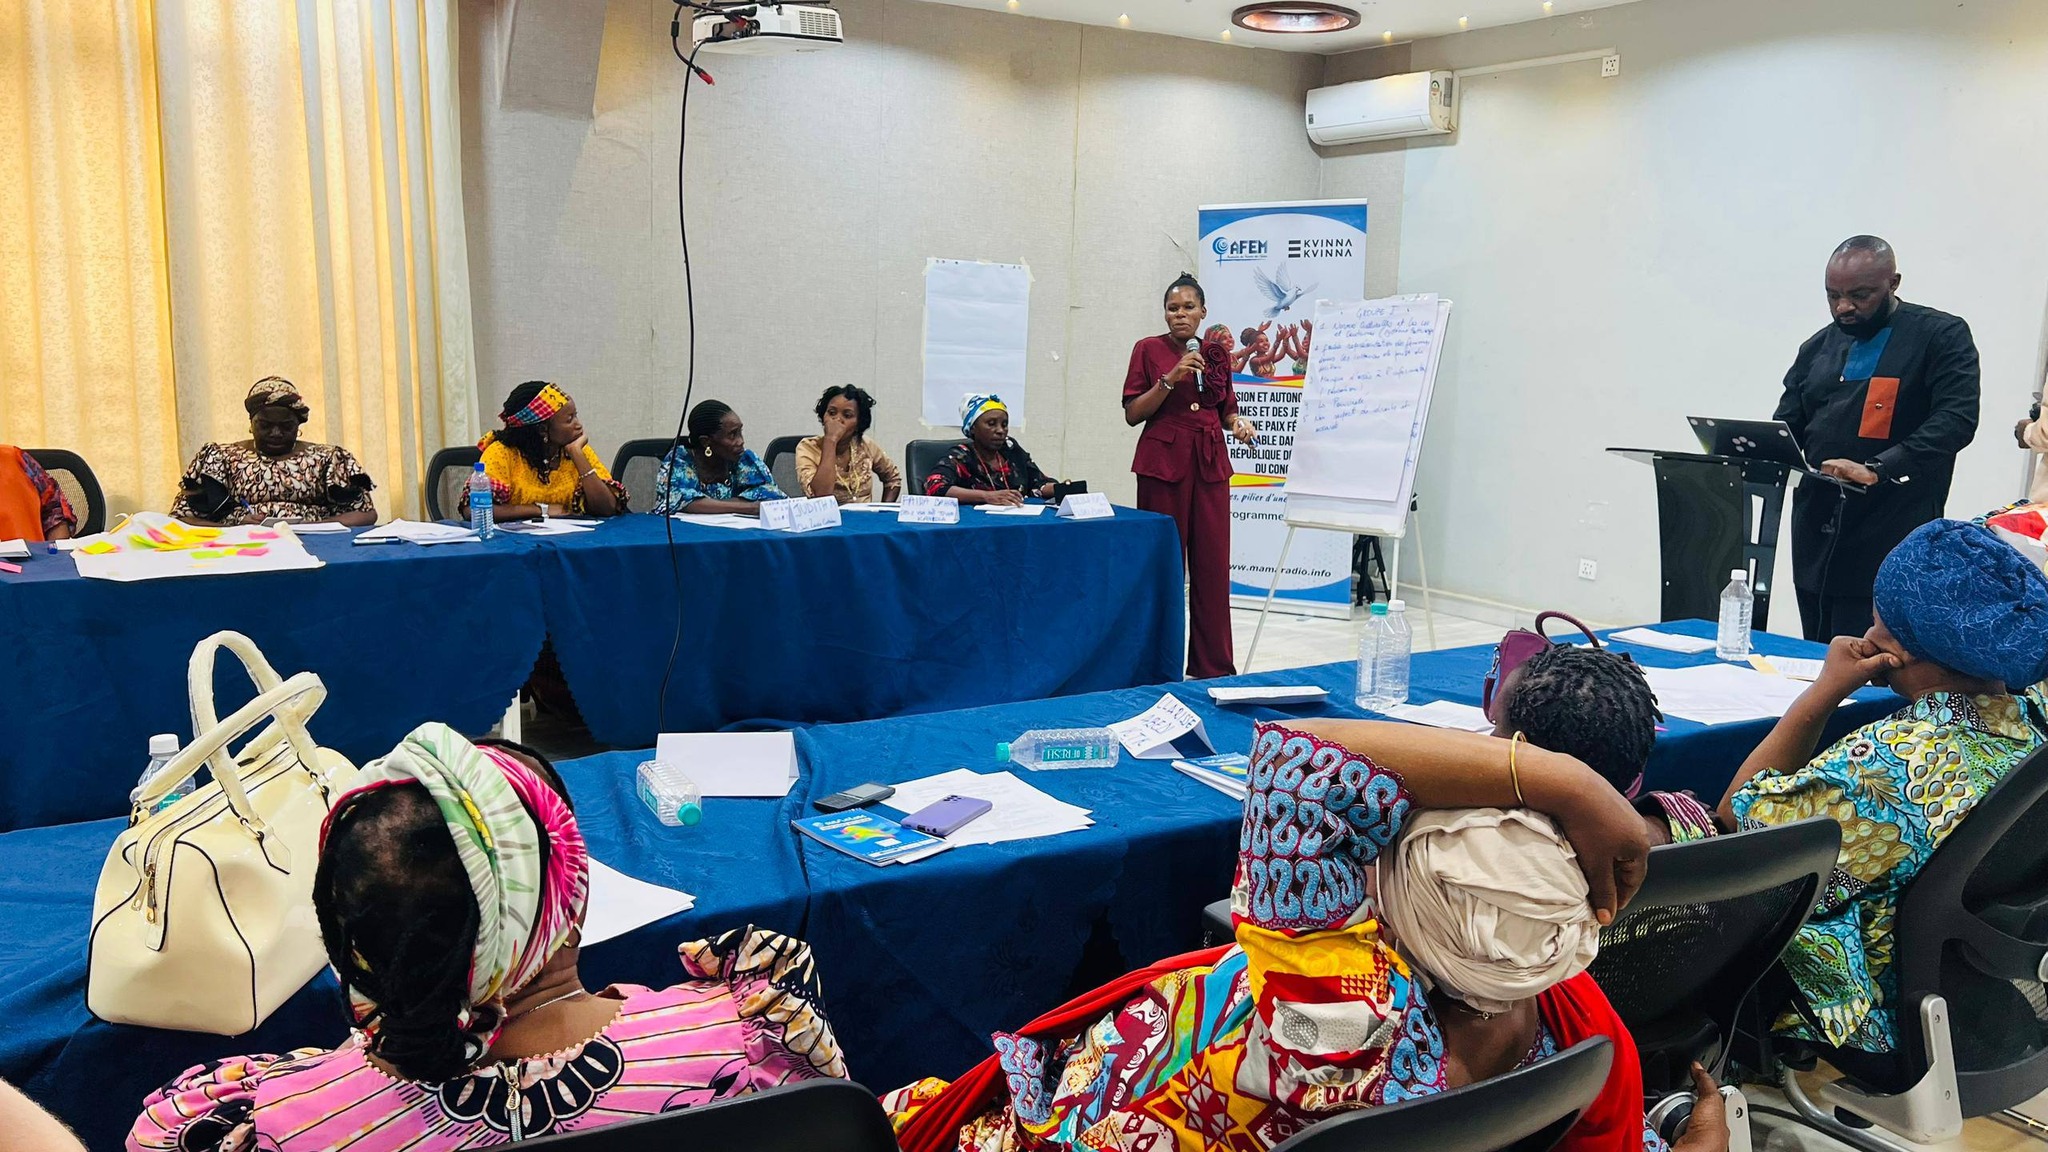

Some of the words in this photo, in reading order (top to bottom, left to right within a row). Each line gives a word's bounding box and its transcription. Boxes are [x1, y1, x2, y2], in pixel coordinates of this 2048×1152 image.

[1230, 239, 1268, 255] AFEM
[1303, 238, 1353, 248] KVINNA
[1303, 248, 1352, 258] KVINNA
[1257, 391, 1268, 402] ET
[1238, 406, 1258, 417] MES
[1260, 406, 1270, 417] ET
[1272, 406, 1288, 418] DES
[1290, 407, 1299, 418] JE
[1250, 420, 1264, 431] NE
[1265, 420, 1285, 432] PAIX
[1230, 446, 1281, 460] RÉPUBLIQUE
[1255, 463, 1267, 474] DU
[1241, 492, 1263, 503] pilier
